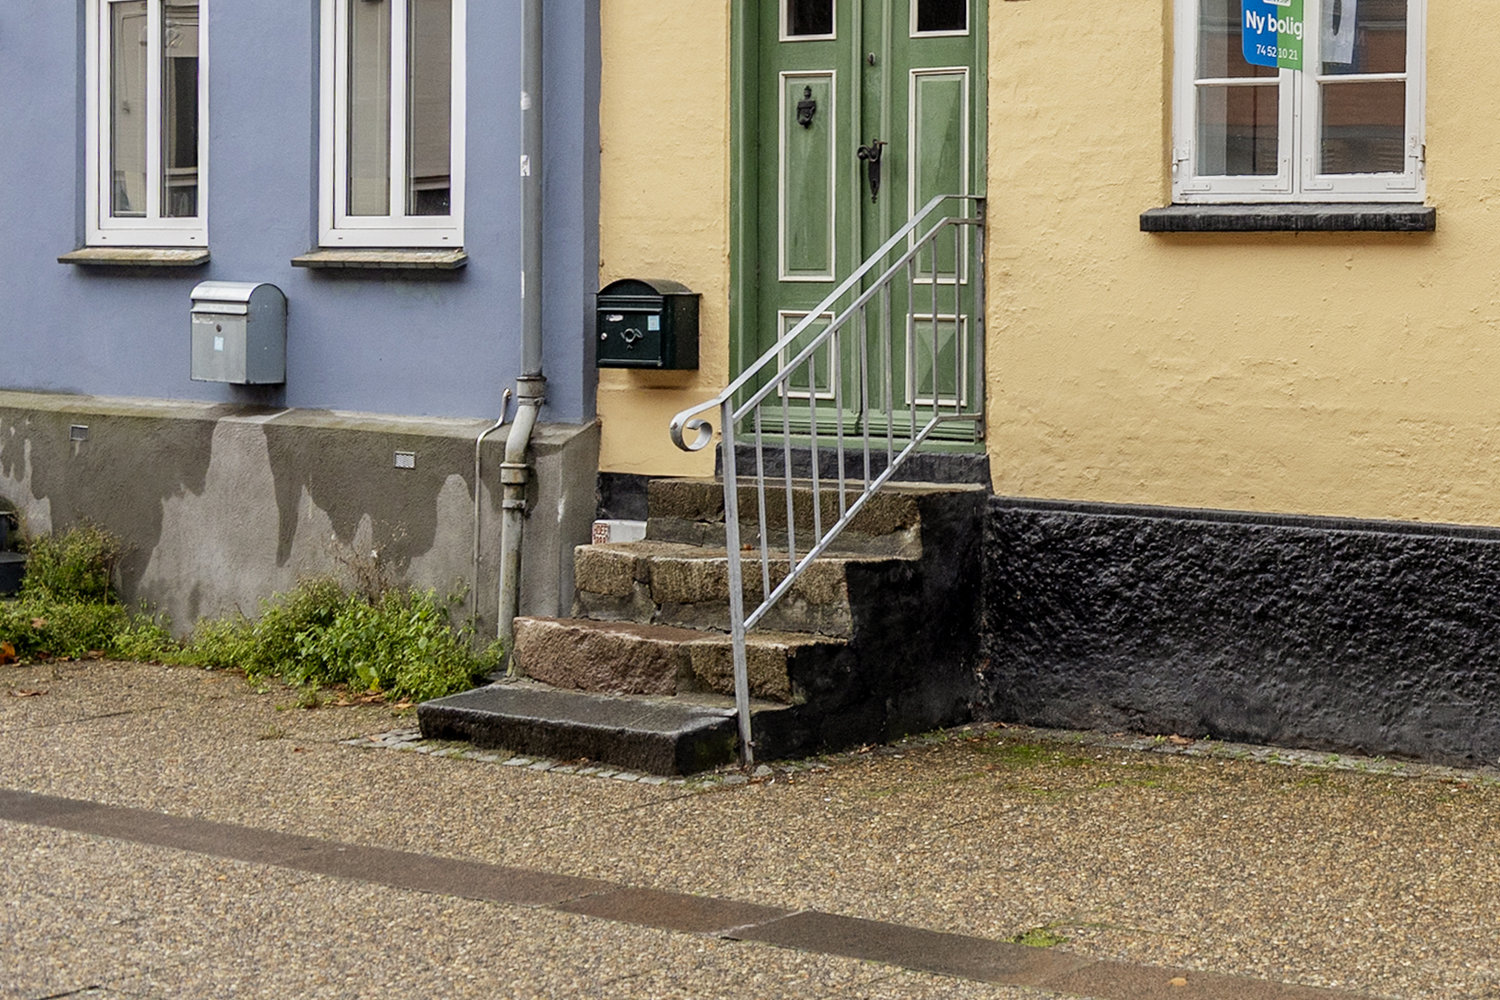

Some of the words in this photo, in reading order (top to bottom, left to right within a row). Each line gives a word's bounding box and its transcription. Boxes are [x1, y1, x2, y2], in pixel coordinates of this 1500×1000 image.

[1245, 9, 1265, 35] Ny
[1256, 44, 1266, 55] 74
[1267, 45, 1277, 58] 52
[1278, 47, 1288, 59] 10
[1288, 48, 1299, 61] 21
